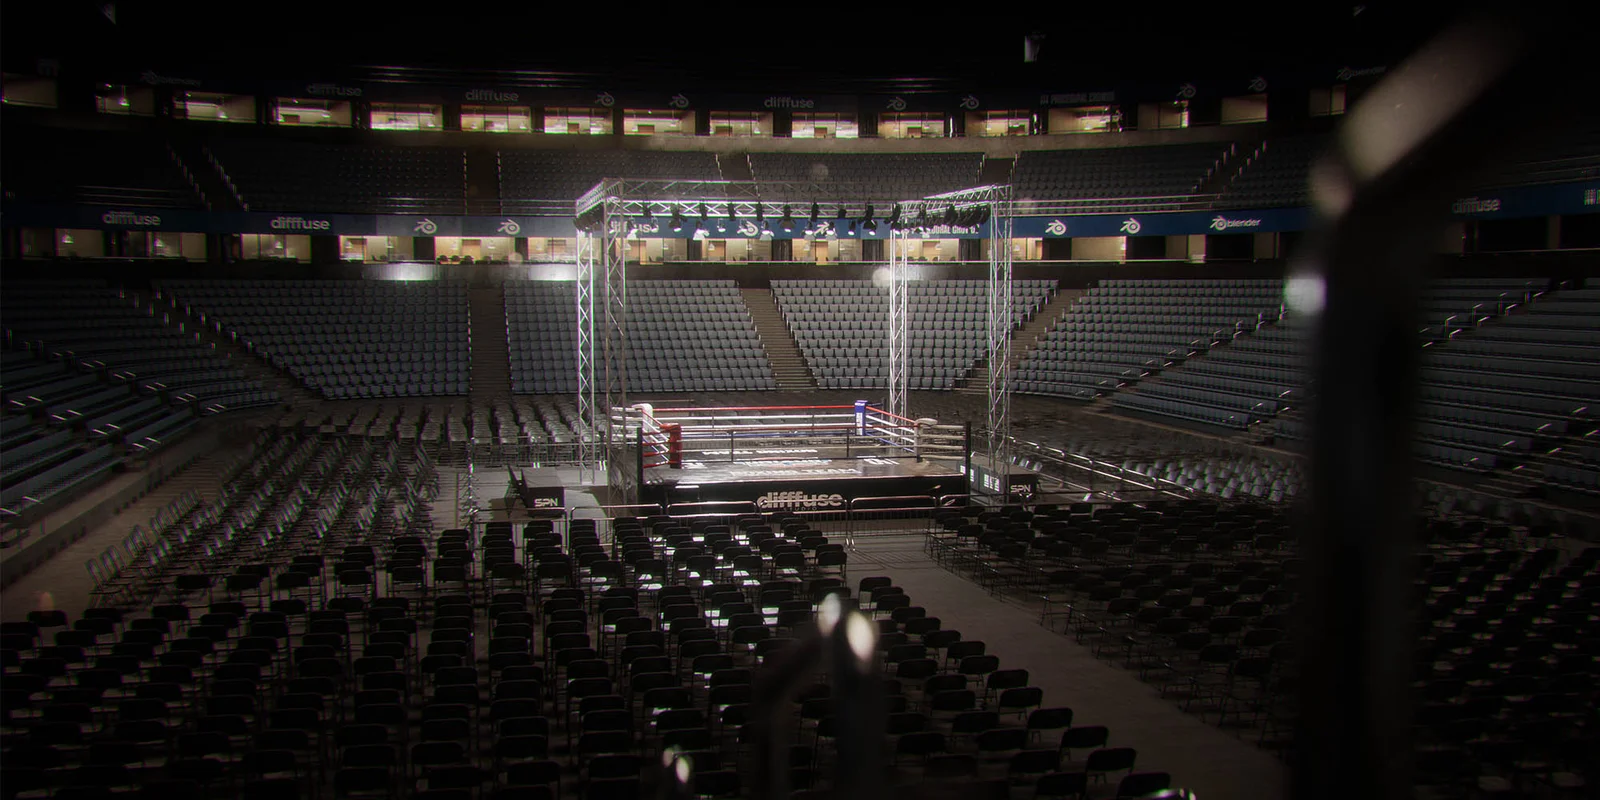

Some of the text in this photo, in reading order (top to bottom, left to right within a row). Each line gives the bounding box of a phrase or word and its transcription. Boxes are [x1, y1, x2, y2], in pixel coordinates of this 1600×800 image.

[764, 96, 815, 109] difffuse
[102, 210, 162, 226] difffuse
[271, 216, 330, 231] difffuse
[1227, 218, 1262, 228] blender
[1010, 484, 1031, 493] SPN
[534, 498, 558, 507] SPN
[757, 491, 843, 509] difffuse
